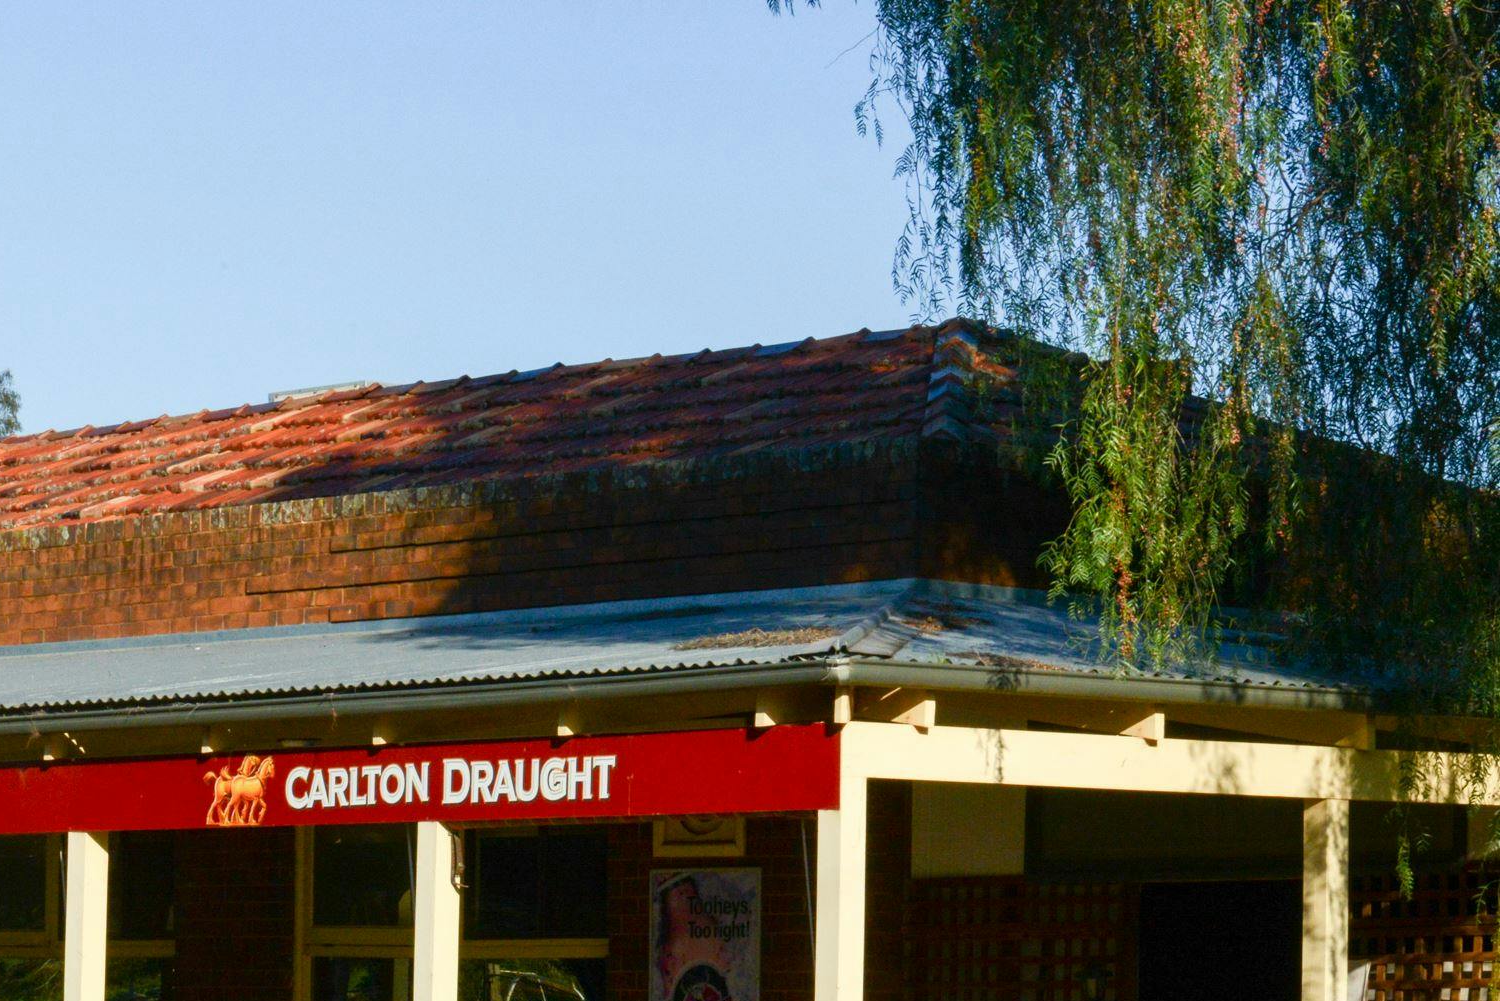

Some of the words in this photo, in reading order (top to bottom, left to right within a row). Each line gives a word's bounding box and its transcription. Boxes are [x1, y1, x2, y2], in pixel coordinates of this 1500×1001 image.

[284, 761, 430, 810] CARLTON
[440, 755, 617, 805] DRAUGHT
[687, 921, 712, 938] Too
